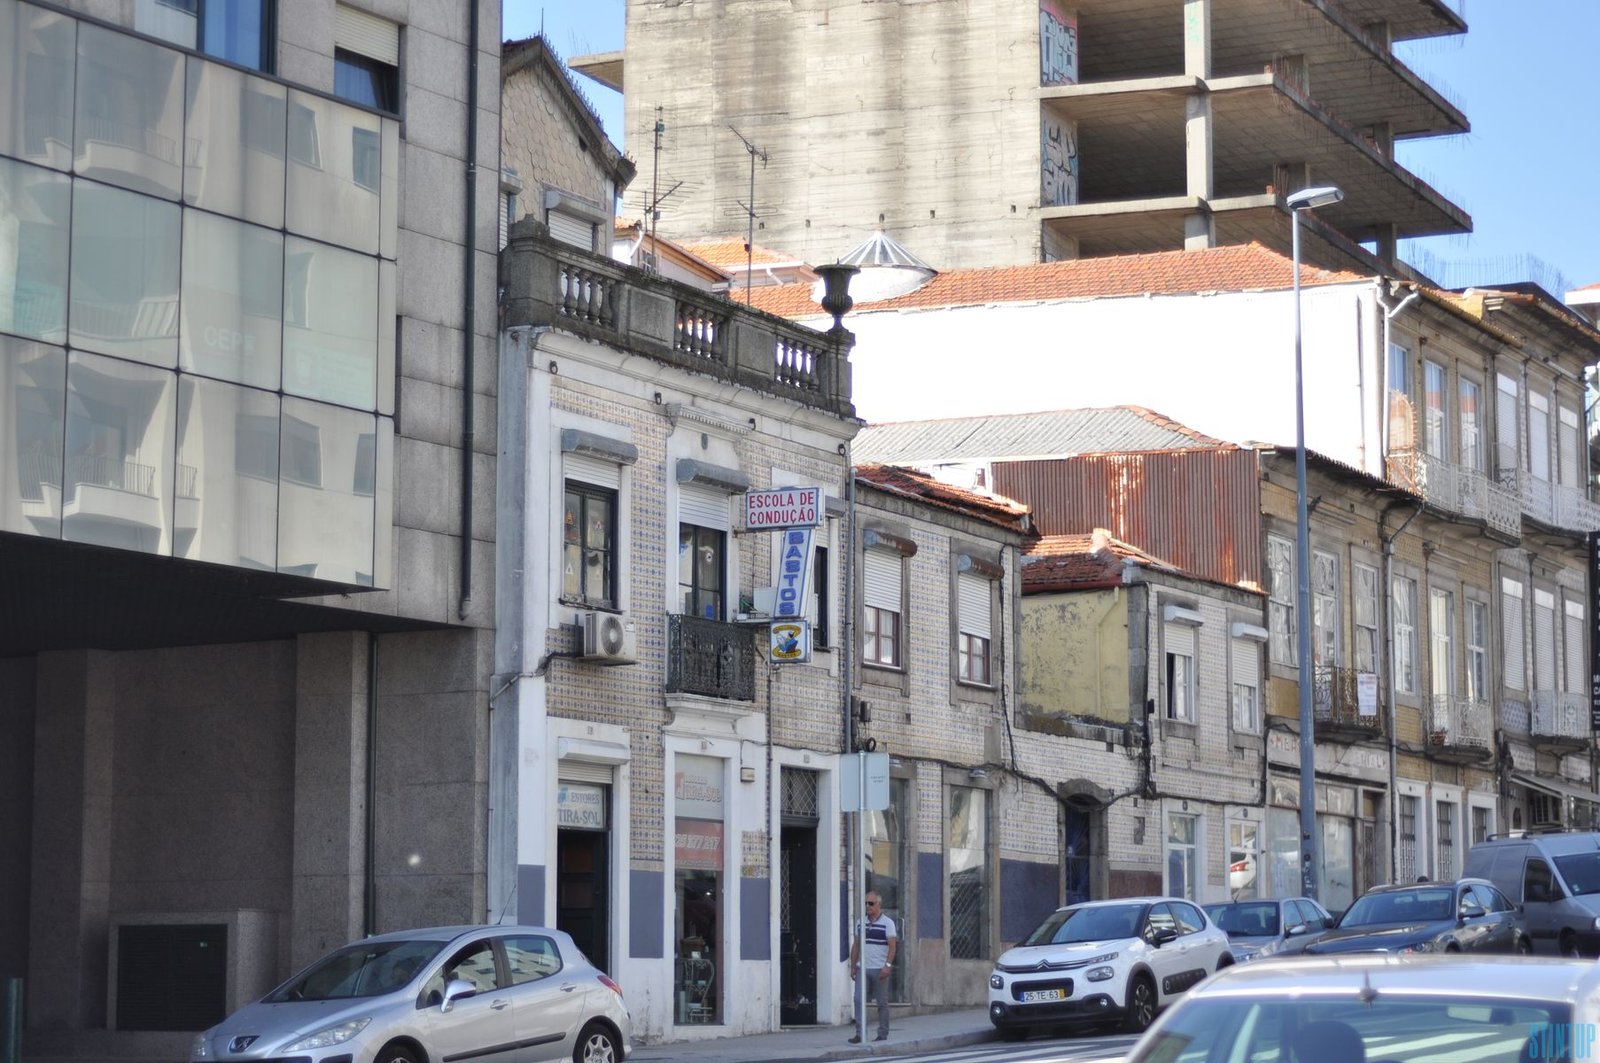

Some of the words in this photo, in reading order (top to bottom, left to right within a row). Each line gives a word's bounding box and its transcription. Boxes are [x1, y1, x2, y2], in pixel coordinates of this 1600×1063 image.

[749, 493, 794, 509] ESCOLA
[800, 491, 815, 506] DE
[749, 507, 815, 525] CONDUÇÃO
[778, 531, 805, 616] BASTOS
[571, 792, 600, 804] ESTORES
[558, 808, 600, 825] TIRA-SOL
